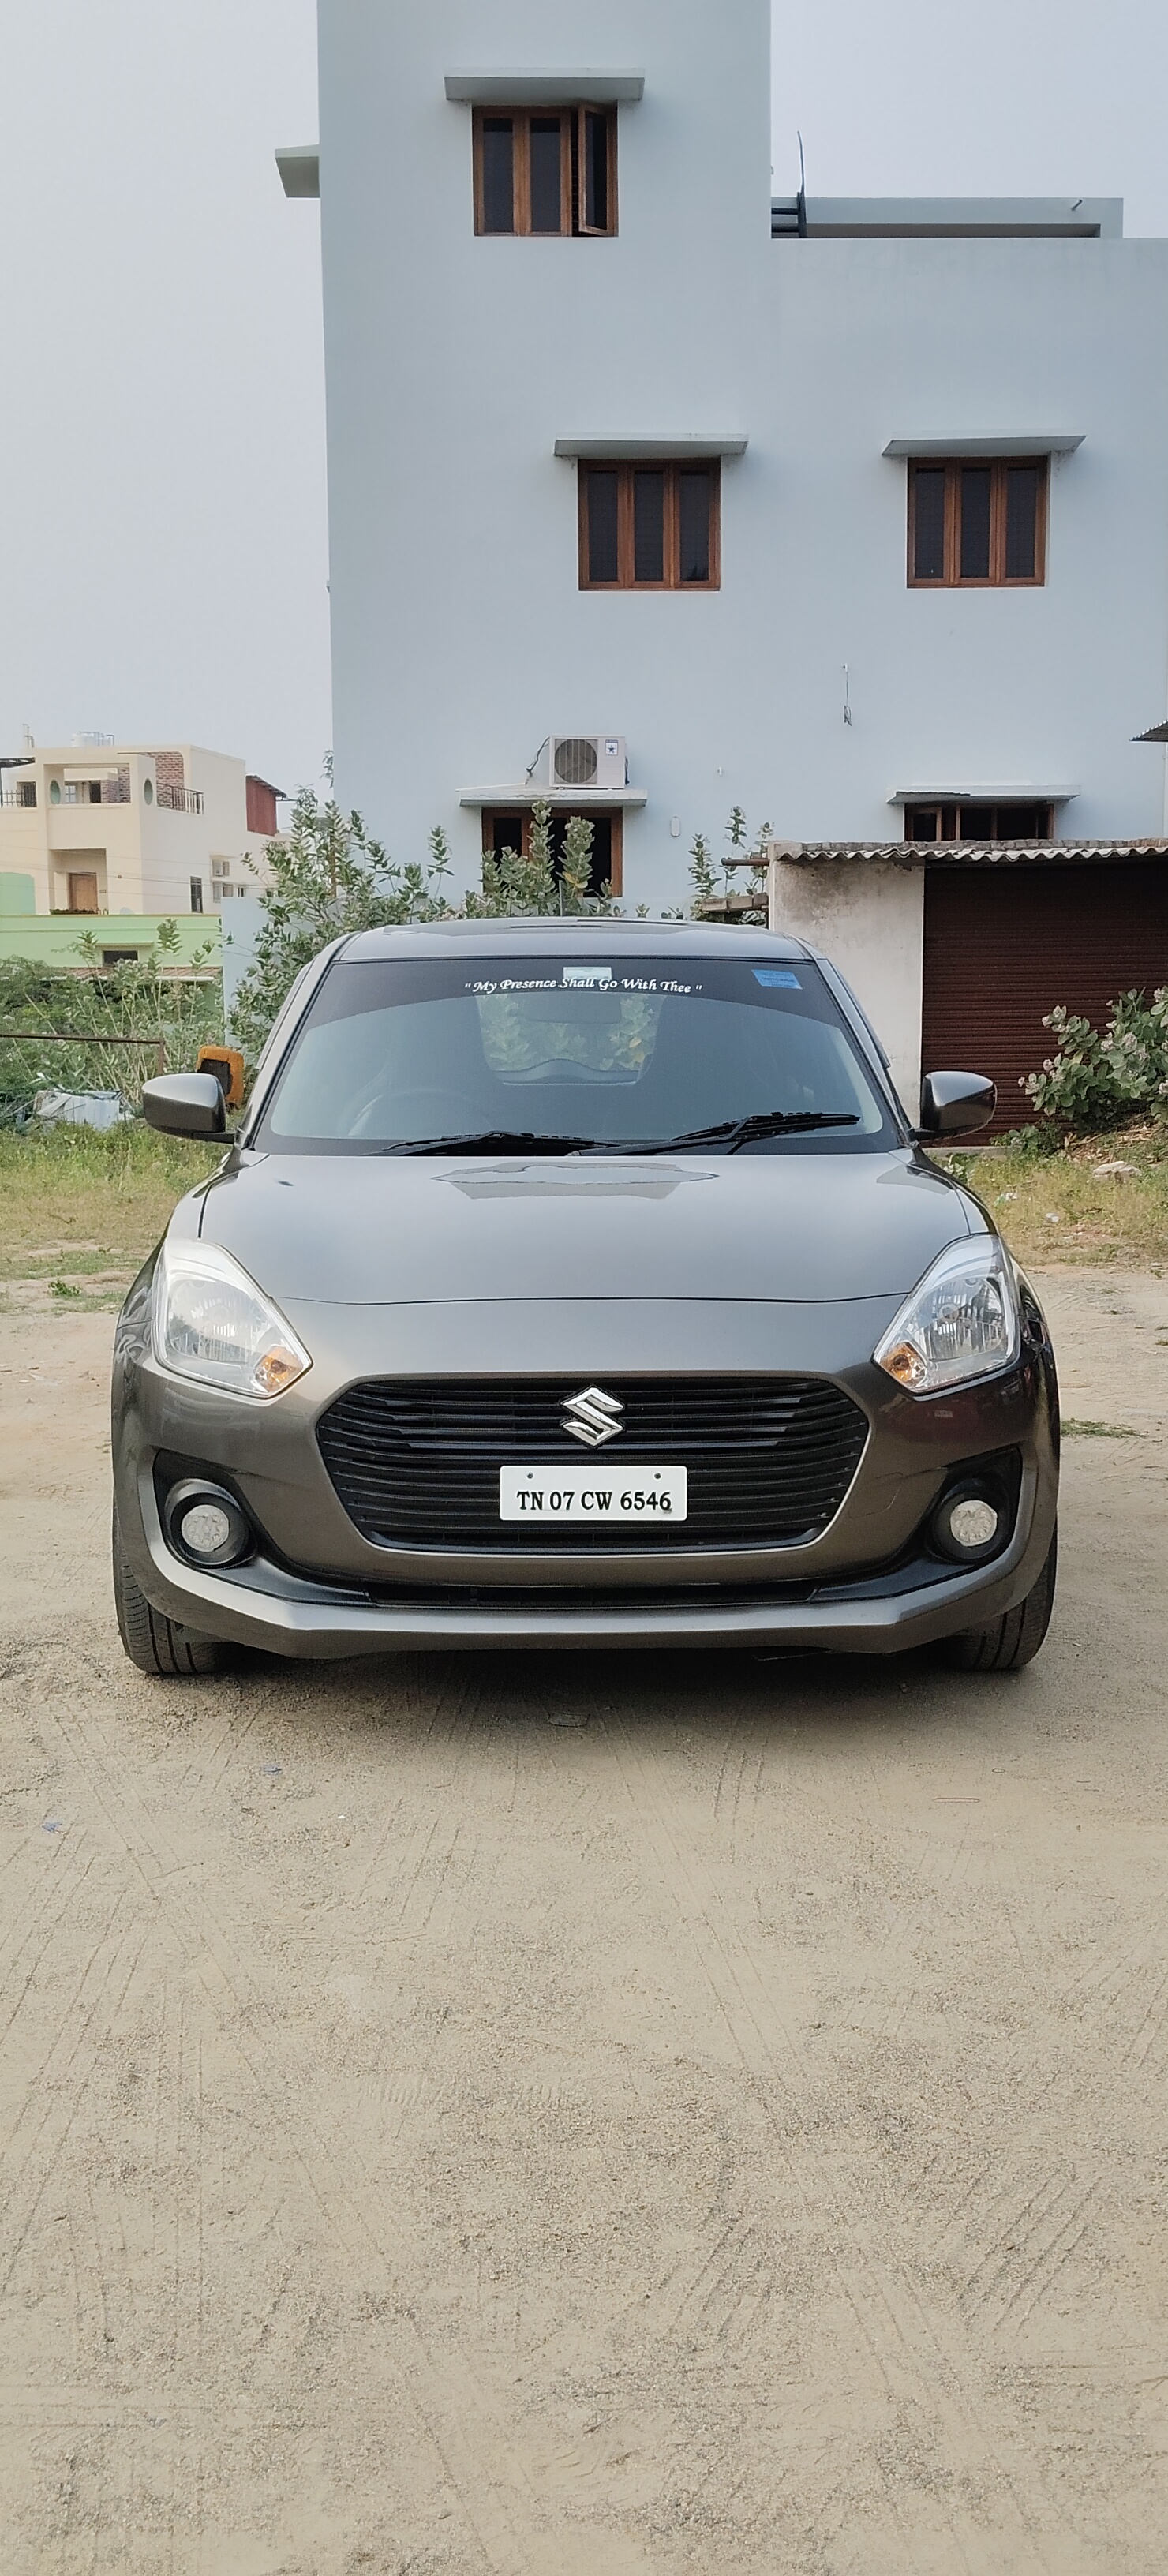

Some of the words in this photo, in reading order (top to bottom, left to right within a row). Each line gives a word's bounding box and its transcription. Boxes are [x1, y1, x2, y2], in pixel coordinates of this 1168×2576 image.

[500, 979, 556, 990] Presence
[558, 976, 595, 988] Shall
[598, 978, 618, 990] Go
[620, 978, 657, 990] With
[660, 980, 691, 993] Thee
[517, 1491, 544, 1510] TN
[549, 1491, 575, 1510] 07
[581, 1491, 612, 1510] CW
[620, 1491, 671, 1511] 6546
